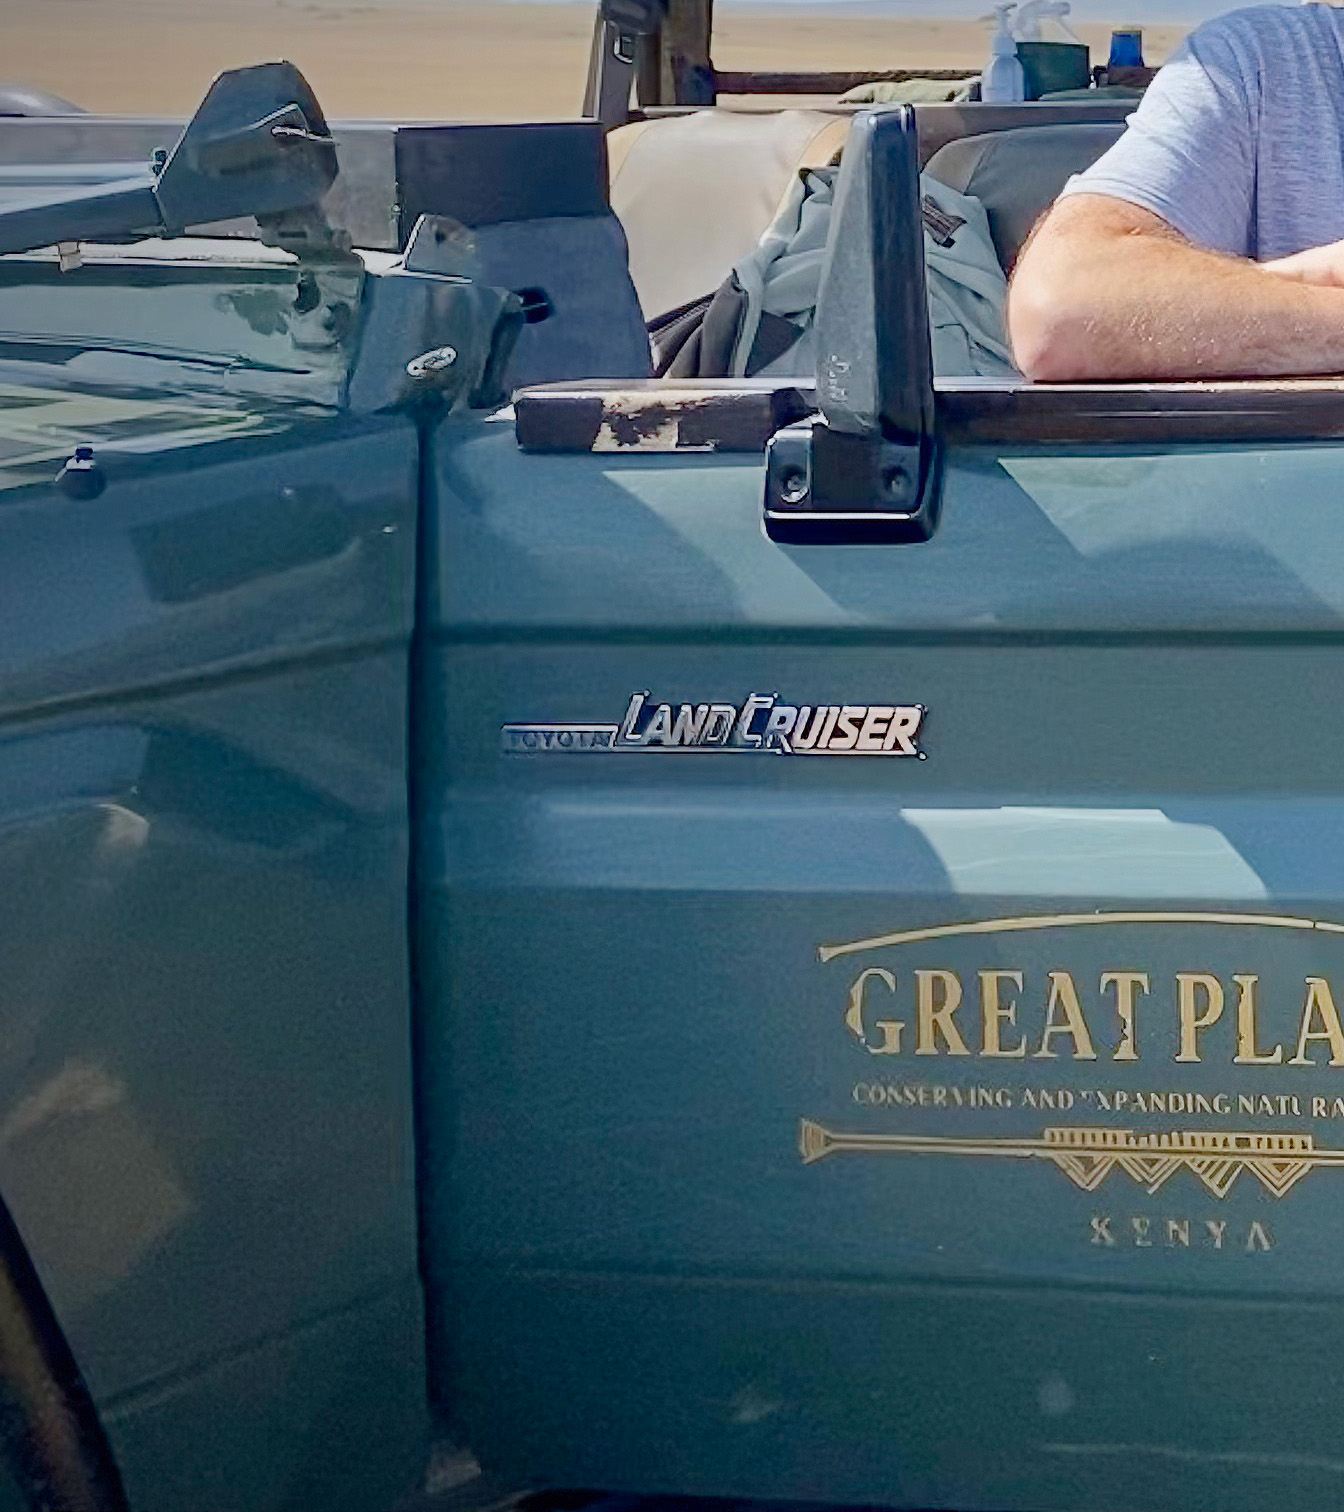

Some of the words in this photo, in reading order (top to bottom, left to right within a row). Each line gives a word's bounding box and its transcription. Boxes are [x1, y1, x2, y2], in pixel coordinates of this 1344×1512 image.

[618, 691, 737, 747] LAND
[739, 692, 925, 755] CRUISER
[845, 968, 1150, 1060] GREAT
[1022, 1087, 1074, 1109] AND
[1081, 1089, 1231, 1114] XPANDING
[1090, 1216, 1271, 1251] KENYA
